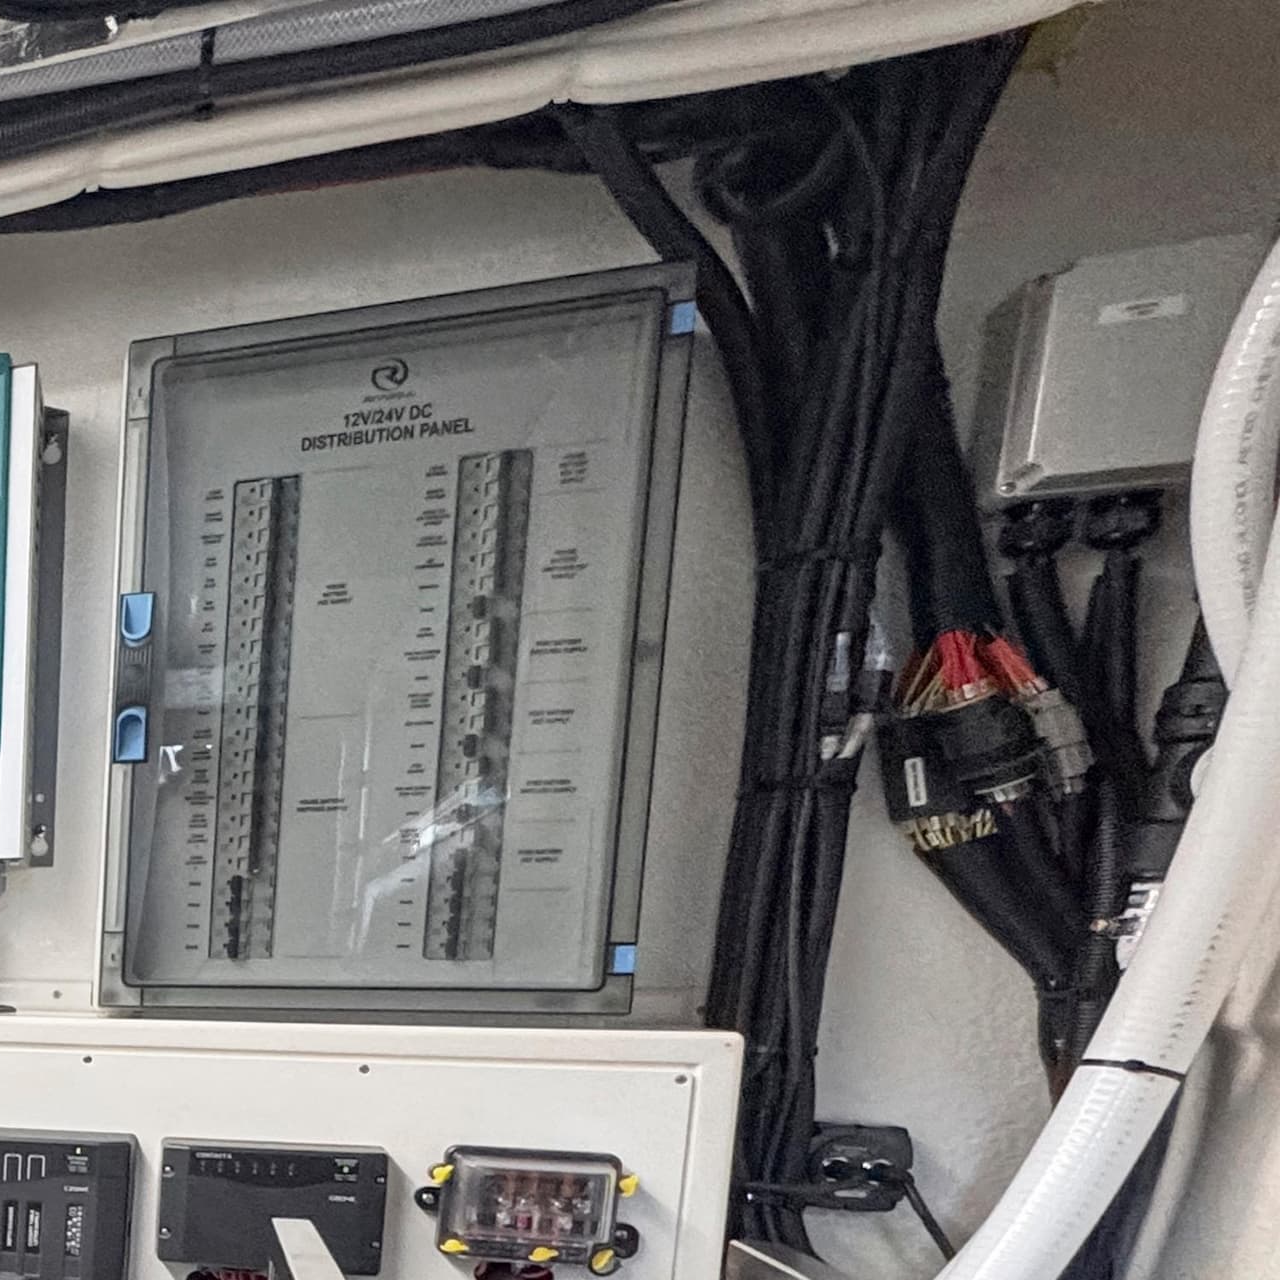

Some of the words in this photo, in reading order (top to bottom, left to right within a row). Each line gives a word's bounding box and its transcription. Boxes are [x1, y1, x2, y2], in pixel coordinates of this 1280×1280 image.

[344, 406, 406, 428] 12V/24V
[410, 403, 432, 420] DC
[301, 425, 414, 452] DISTRIBUTION
[419, 418, 474, 437] PANEL
